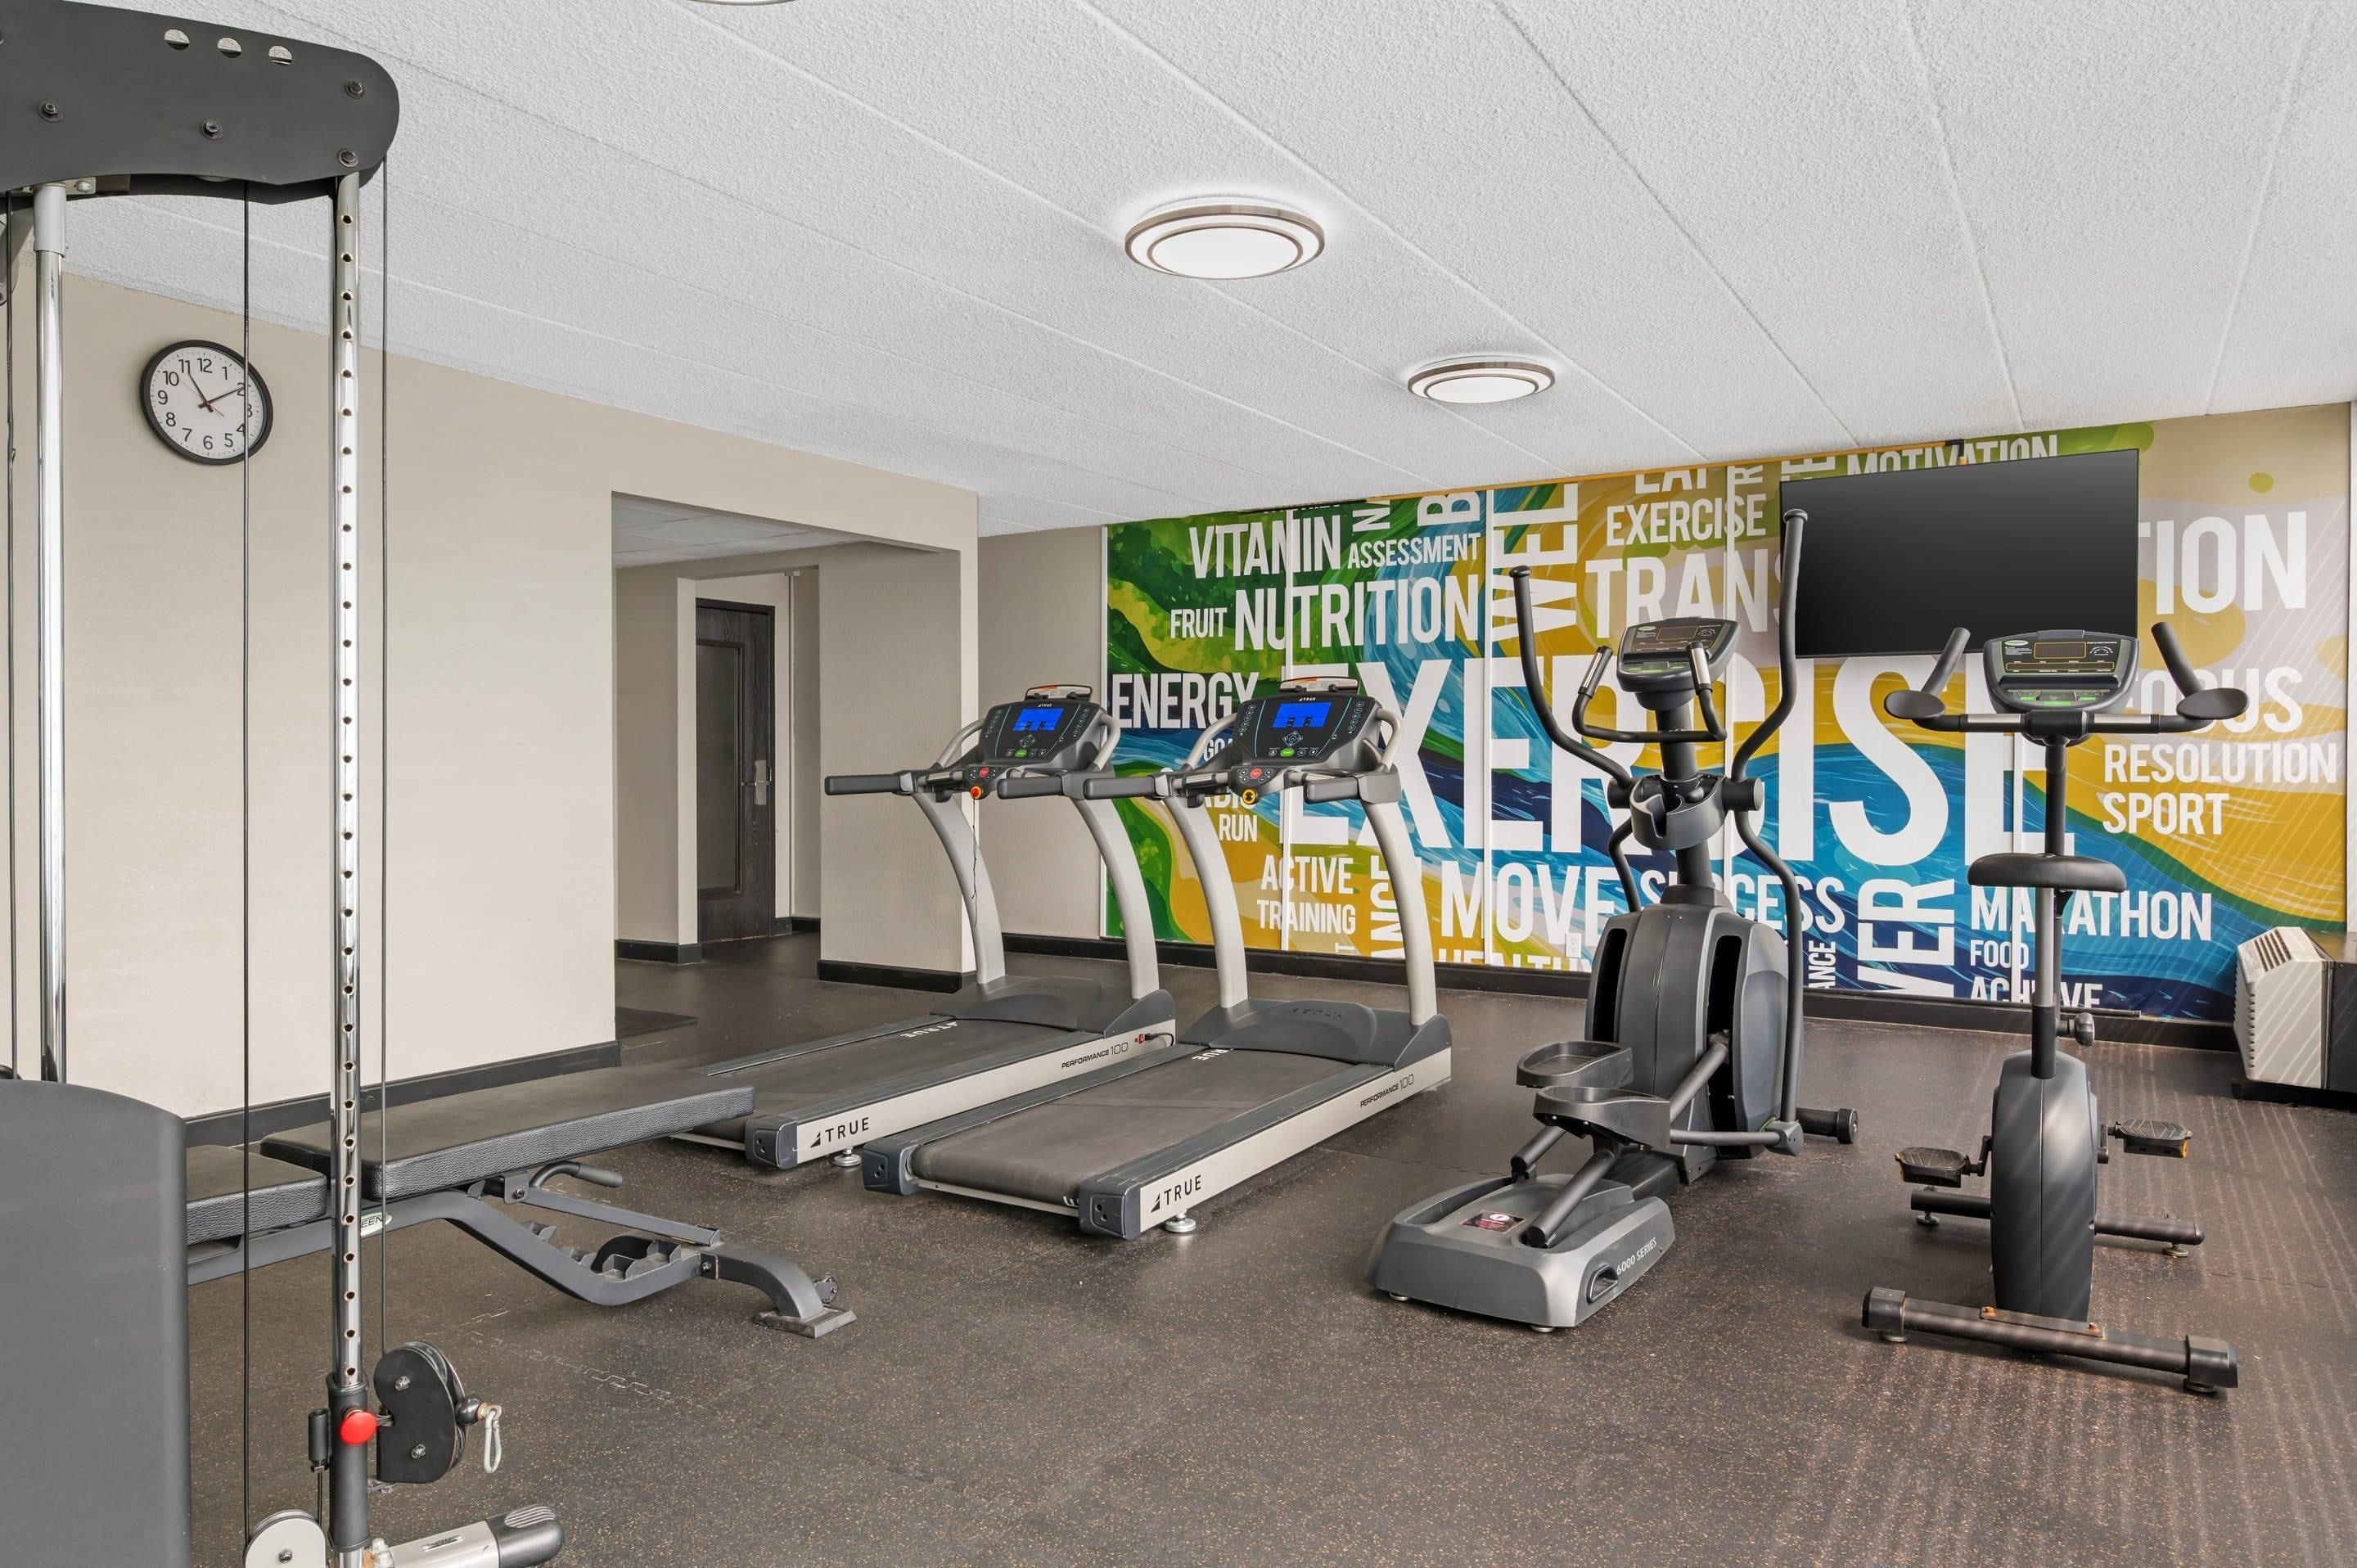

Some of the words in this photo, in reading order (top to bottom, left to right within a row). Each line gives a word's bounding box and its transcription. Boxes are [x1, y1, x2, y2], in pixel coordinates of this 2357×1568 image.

[163, 371, 179, 386] 10
[178, 359, 191, 374] 11
[197, 358, 213, 373] 12
[222, 367, 228, 380] 1
[157, 390, 169, 405] 9
[166, 412, 177, 426] 8
[182, 428, 192, 442] 7
[203, 435, 213, 449] 6
[224, 433, 233, 448] 5
[1606, 493, 1767, 547] EXERCISE
[1189, 515, 1341, 579] VITAMIN
[1347, 532, 1481, 570] ASSESSMENT
[2138, 511, 2307, 615] ION
[1585, 548, 1782, 639] TRAN
[1170, 607, 1228, 639] FRUIT
[1234, 574, 1479, 651] NUTRITION
[1111, 671, 1260, 730] ENERGY
[2126, 666, 2304, 734] OUS
[2104, 742, 2337, 785] RESOLUTION
[1219, 813, 1258, 842] RUN
[2102, 791, 2230, 836] SPORT
[1260, 854, 1354, 894] ACTIVE
[1256, 899, 1356, 935] TRAINING
[1441, 860, 1620, 946] MOVE
[1640, 869, 1846, 934] SCESS
[1971, 885, 2212, 941] MAATHON
[1970, 975, 2103, 1009] ACHVE
[1061, 1049, 1110, 1069] PERFORMANCE
[1111, 1042, 1129, 1056] 100
[1360, 1083, 1399, 1108] PERFORMANCE
[1399, 1073, 1414, 1089] 100
[825, 1116, 870, 1144] TRUE
[1163, 1174, 1202, 1205] TRUE
[1616, 1255, 1636, 1275] 6000
[1636, 1237, 1657, 1261] SERIES
